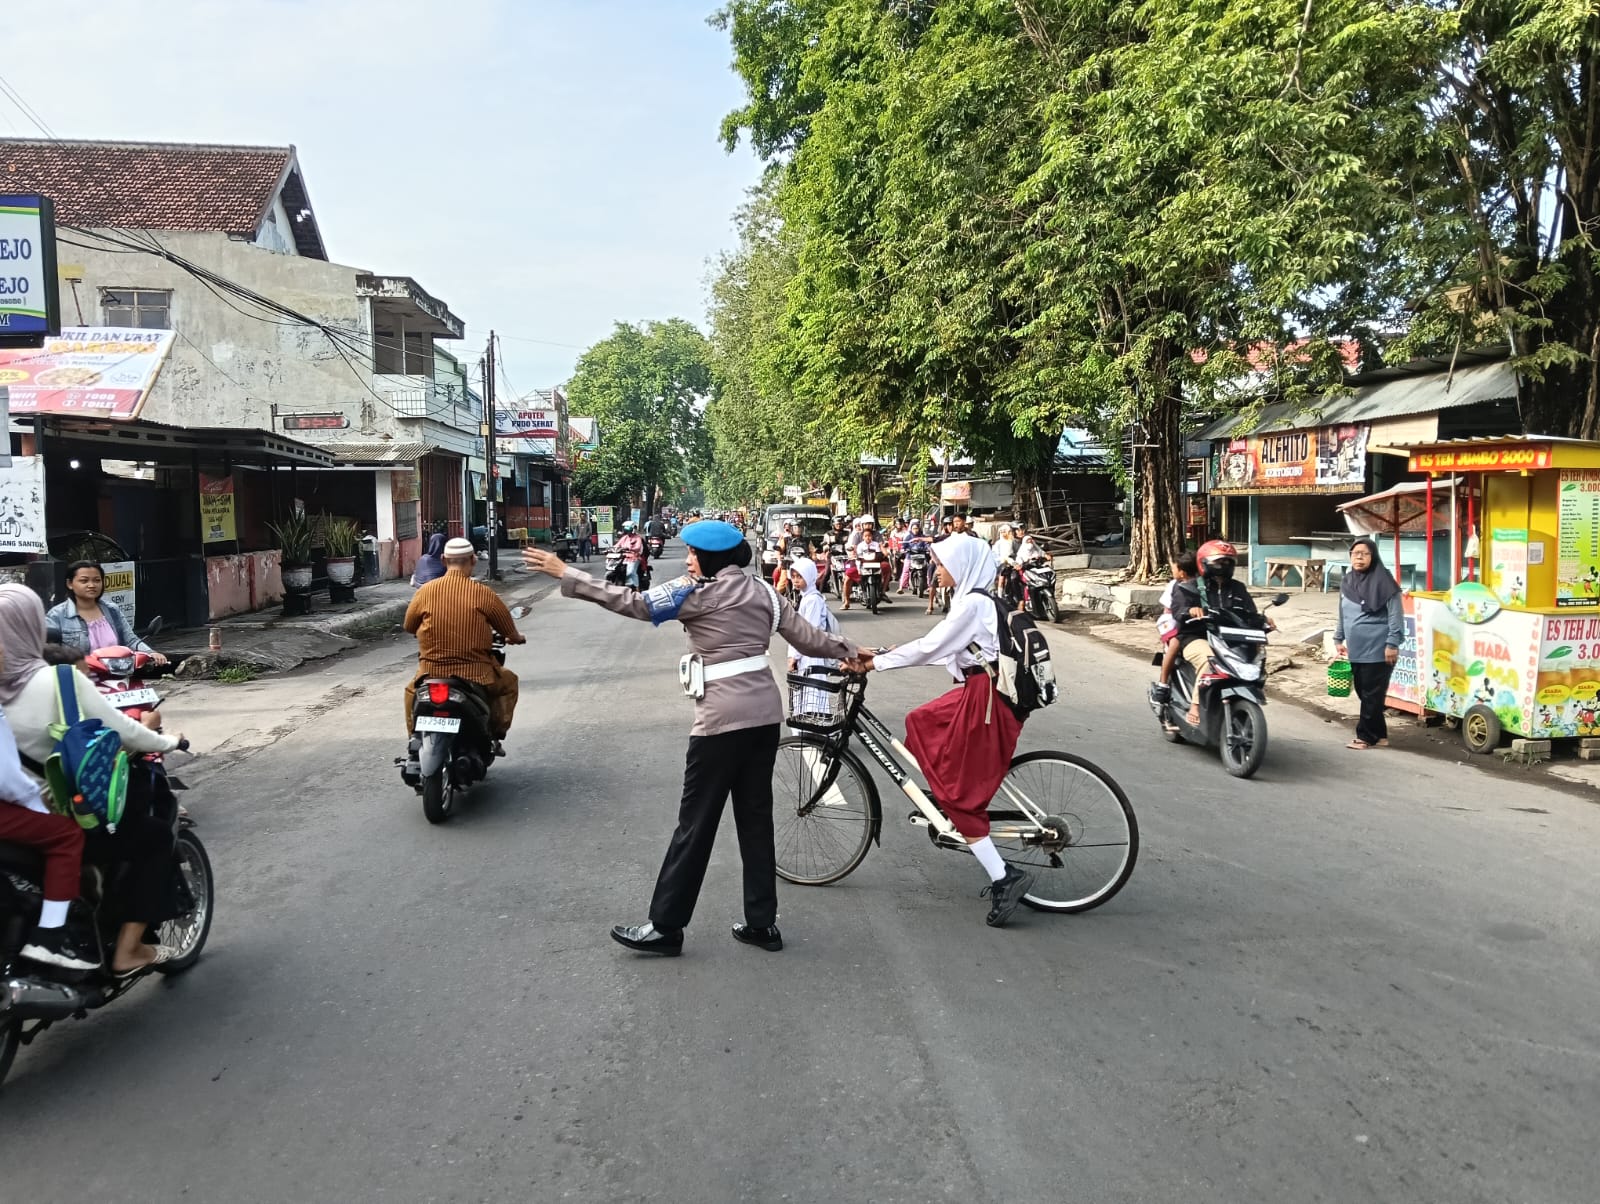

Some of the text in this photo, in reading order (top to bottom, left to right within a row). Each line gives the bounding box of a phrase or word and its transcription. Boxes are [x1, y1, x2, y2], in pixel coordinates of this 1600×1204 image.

[0, 239, 32, 260] EJO
[90, 332, 121, 341] DAN
[1262, 433, 1308, 464] ALFHITO
[1419, 454, 1434, 467] ES
[1457, 450, 1499, 466] JUMBO
[1501, 449, 1535, 464] 3000
[104, 573, 131, 589] DIJUAL
[1546, 619, 1600, 641] ES TEH JU
[1473, 639, 1511, 662] KIARA
[859, 732, 905, 781] PHOENIX
